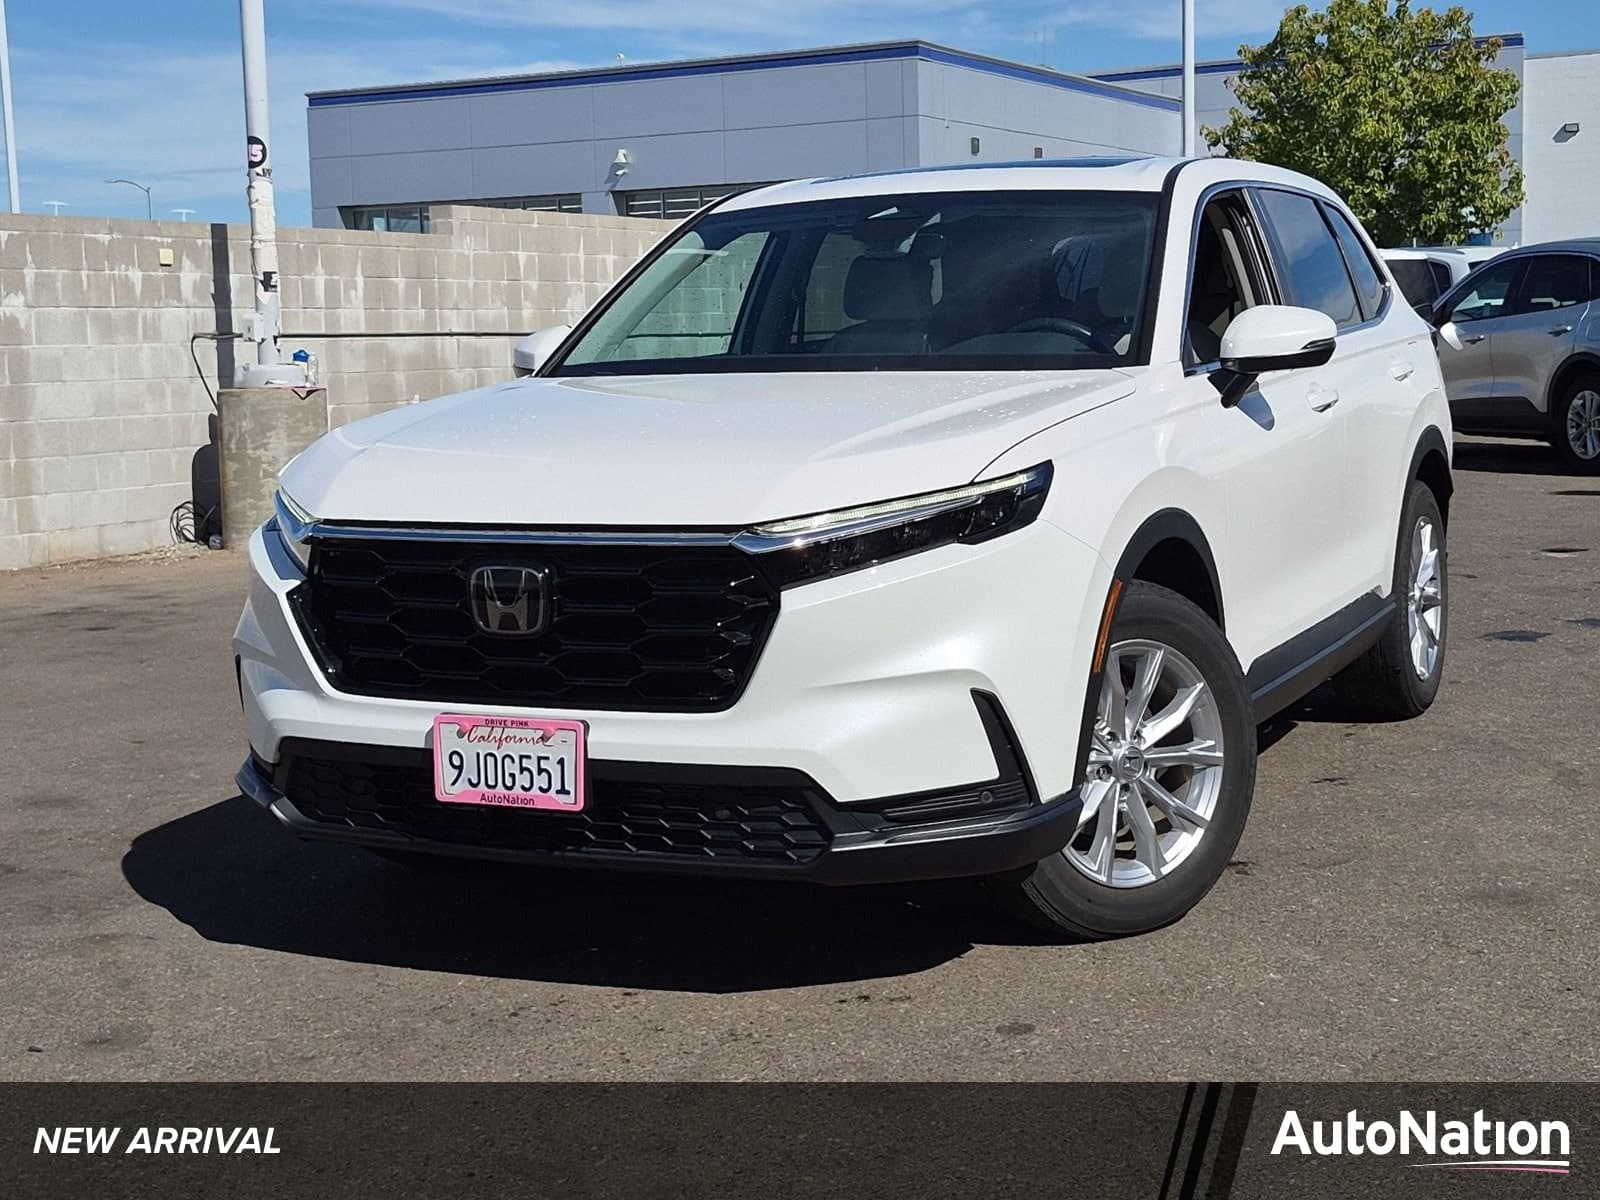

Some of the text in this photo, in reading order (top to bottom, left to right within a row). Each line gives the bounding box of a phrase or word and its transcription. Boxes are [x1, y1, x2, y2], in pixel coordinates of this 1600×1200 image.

[484, 719, 508, 727] DRIVE
[467, 726, 553, 750] California
[480, 793, 535, 806] AutoNation
